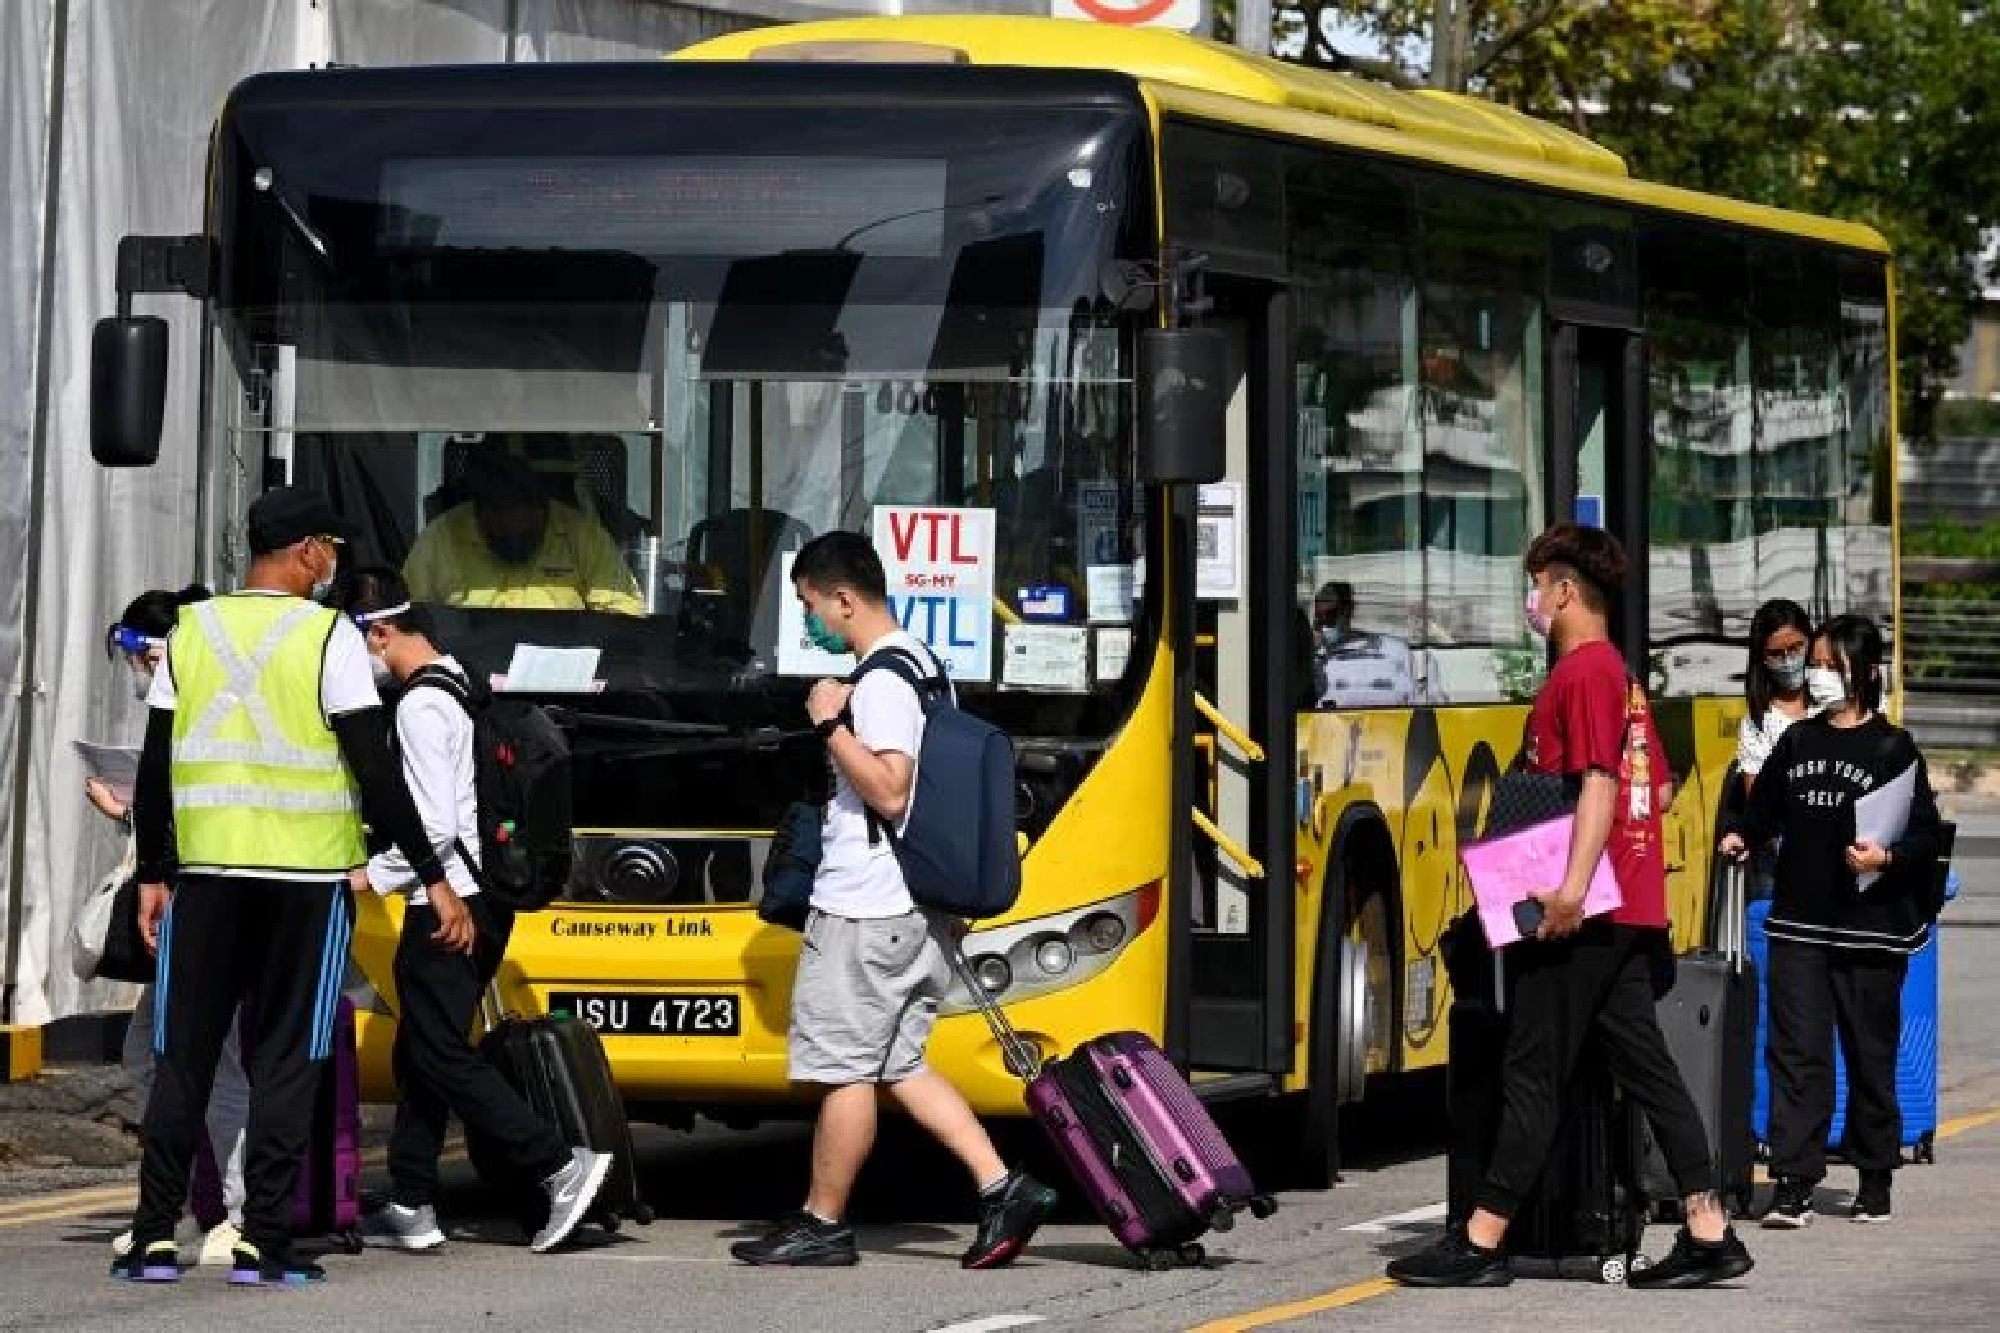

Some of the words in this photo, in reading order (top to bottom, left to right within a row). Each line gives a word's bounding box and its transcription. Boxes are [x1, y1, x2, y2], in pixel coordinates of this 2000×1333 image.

[889, 512, 978, 564] VTL
[886, 596, 976, 647] VTL
[551, 917, 656, 941] Causeway
[667, 917, 713, 937] Link
[650, 998, 735, 1031] 4723
